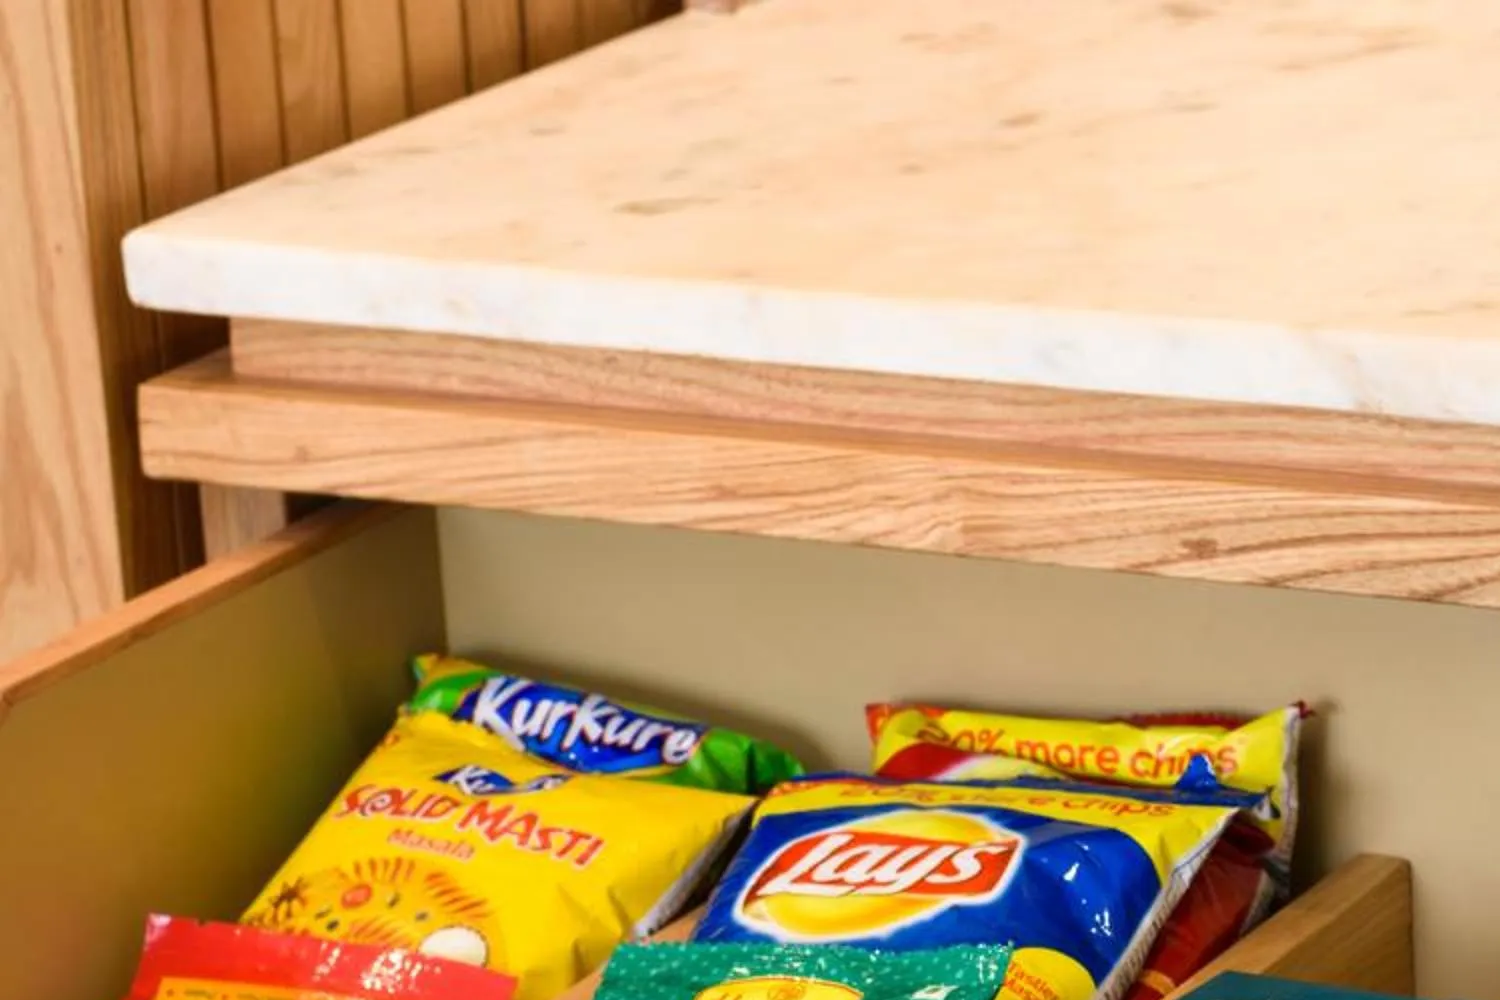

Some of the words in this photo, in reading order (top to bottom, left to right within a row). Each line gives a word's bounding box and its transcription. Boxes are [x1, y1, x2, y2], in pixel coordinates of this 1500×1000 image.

[472, 674, 698, 764] Kurkure
[1015, 738, 1121, 773] more
[386, 828, 475, 862] Masala
[456, 799, 605, 869] MASTI
